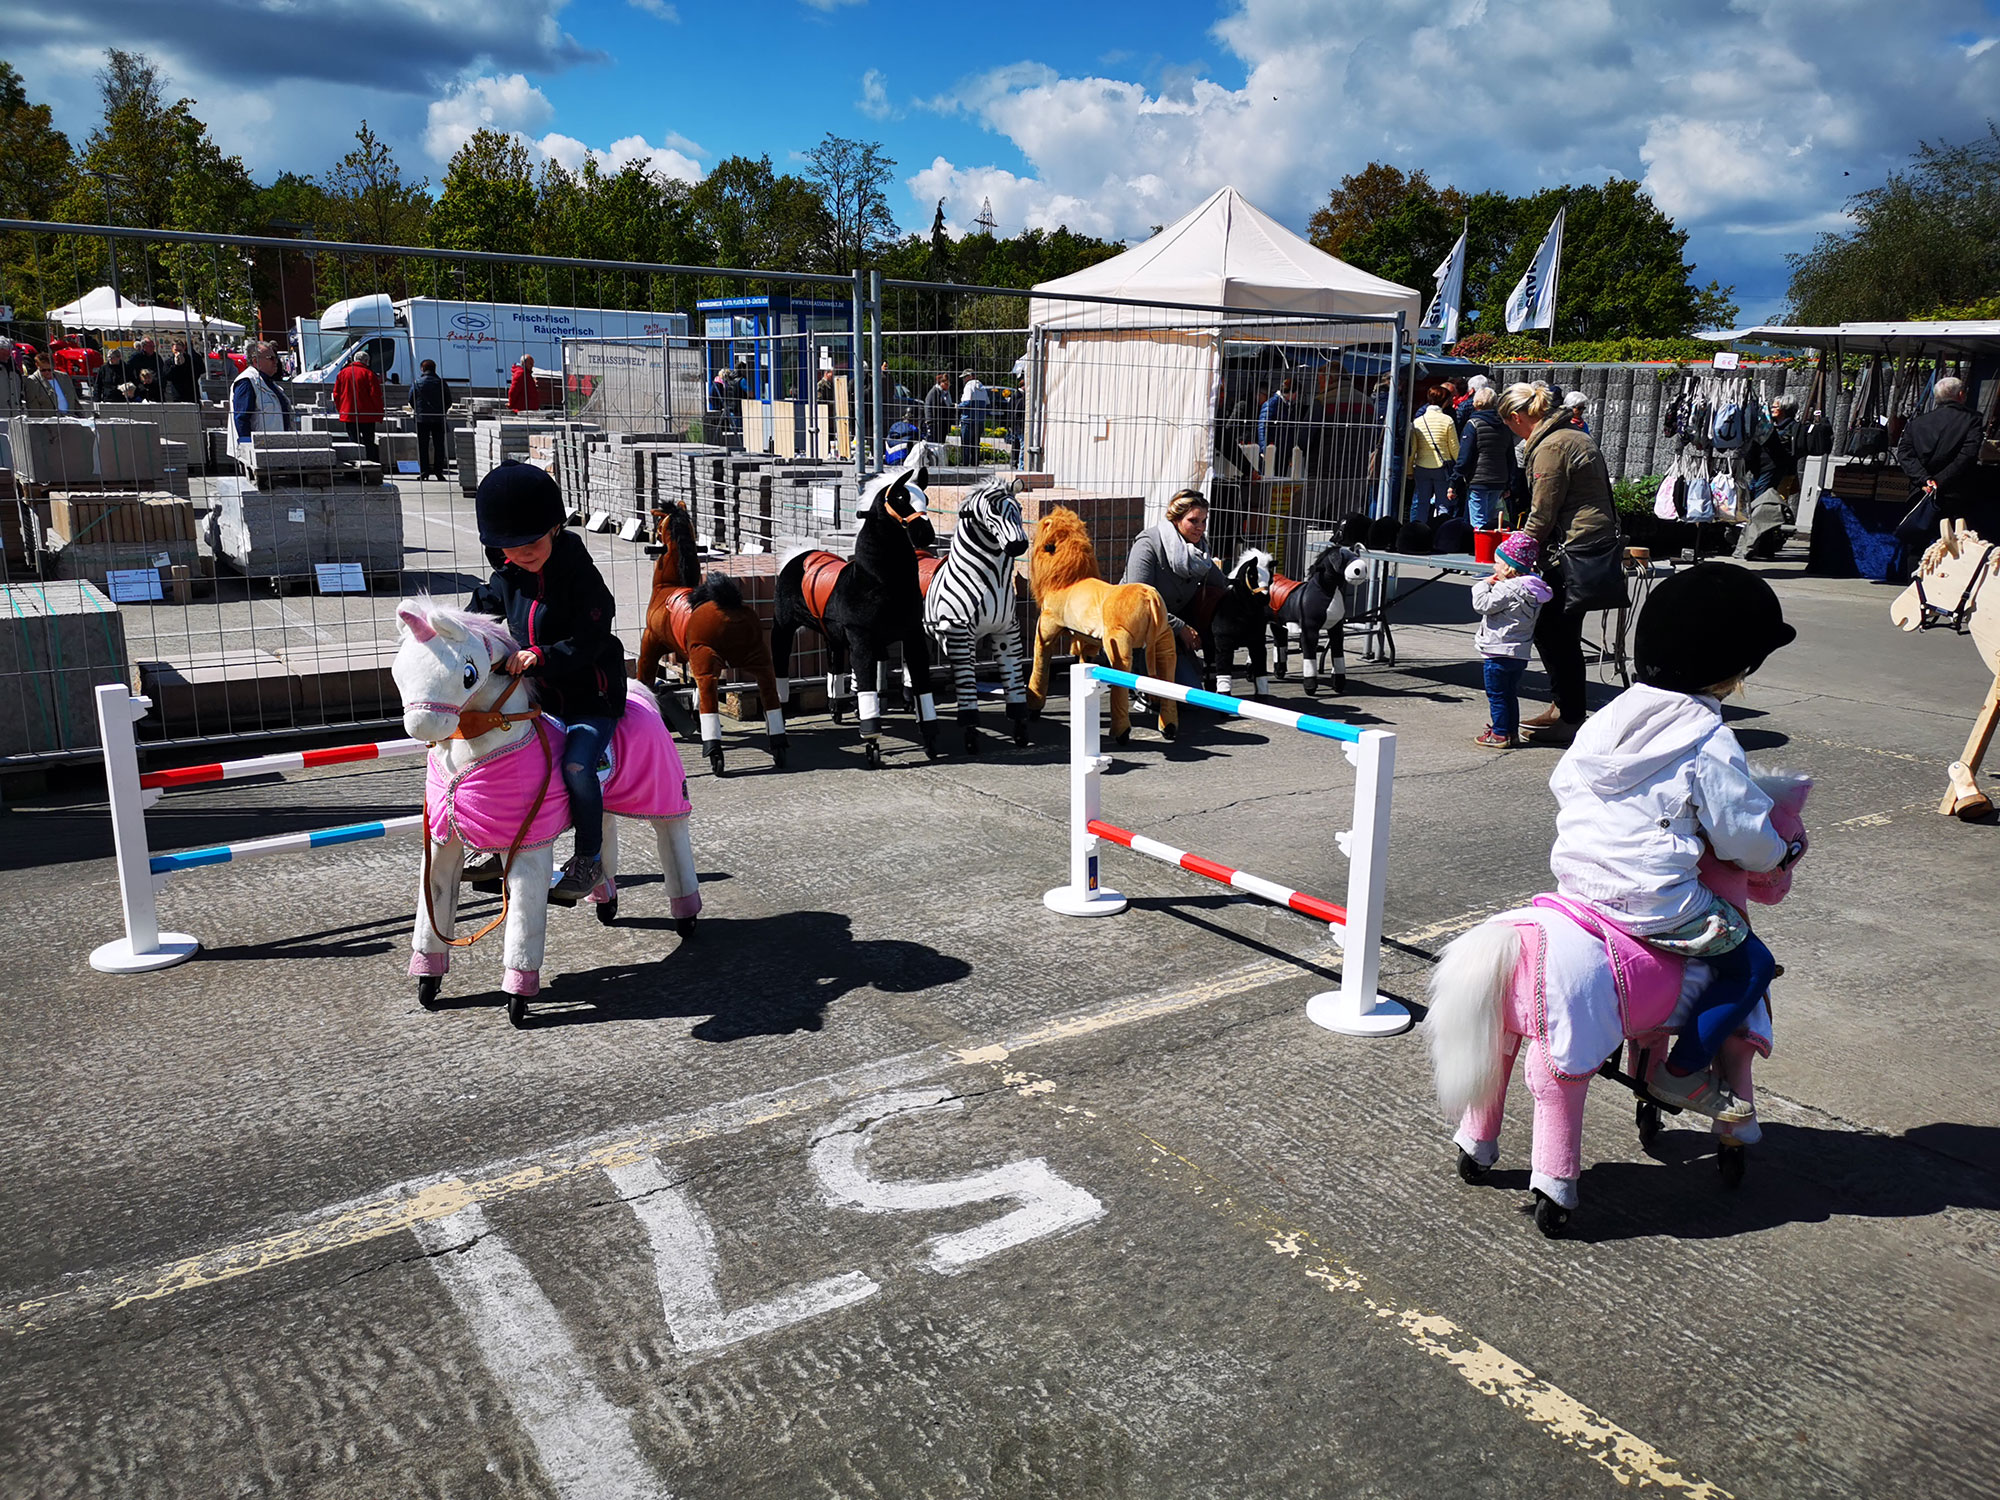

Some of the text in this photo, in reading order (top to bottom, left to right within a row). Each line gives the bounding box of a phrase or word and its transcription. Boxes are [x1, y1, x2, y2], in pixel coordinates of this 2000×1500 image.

[791, 300, 845, 308] WWW.TERASSENWELT.DE
[512, 313, 570, 324] Frisch-Fisch
[533, 325, 594, 336] Räucherfisch
